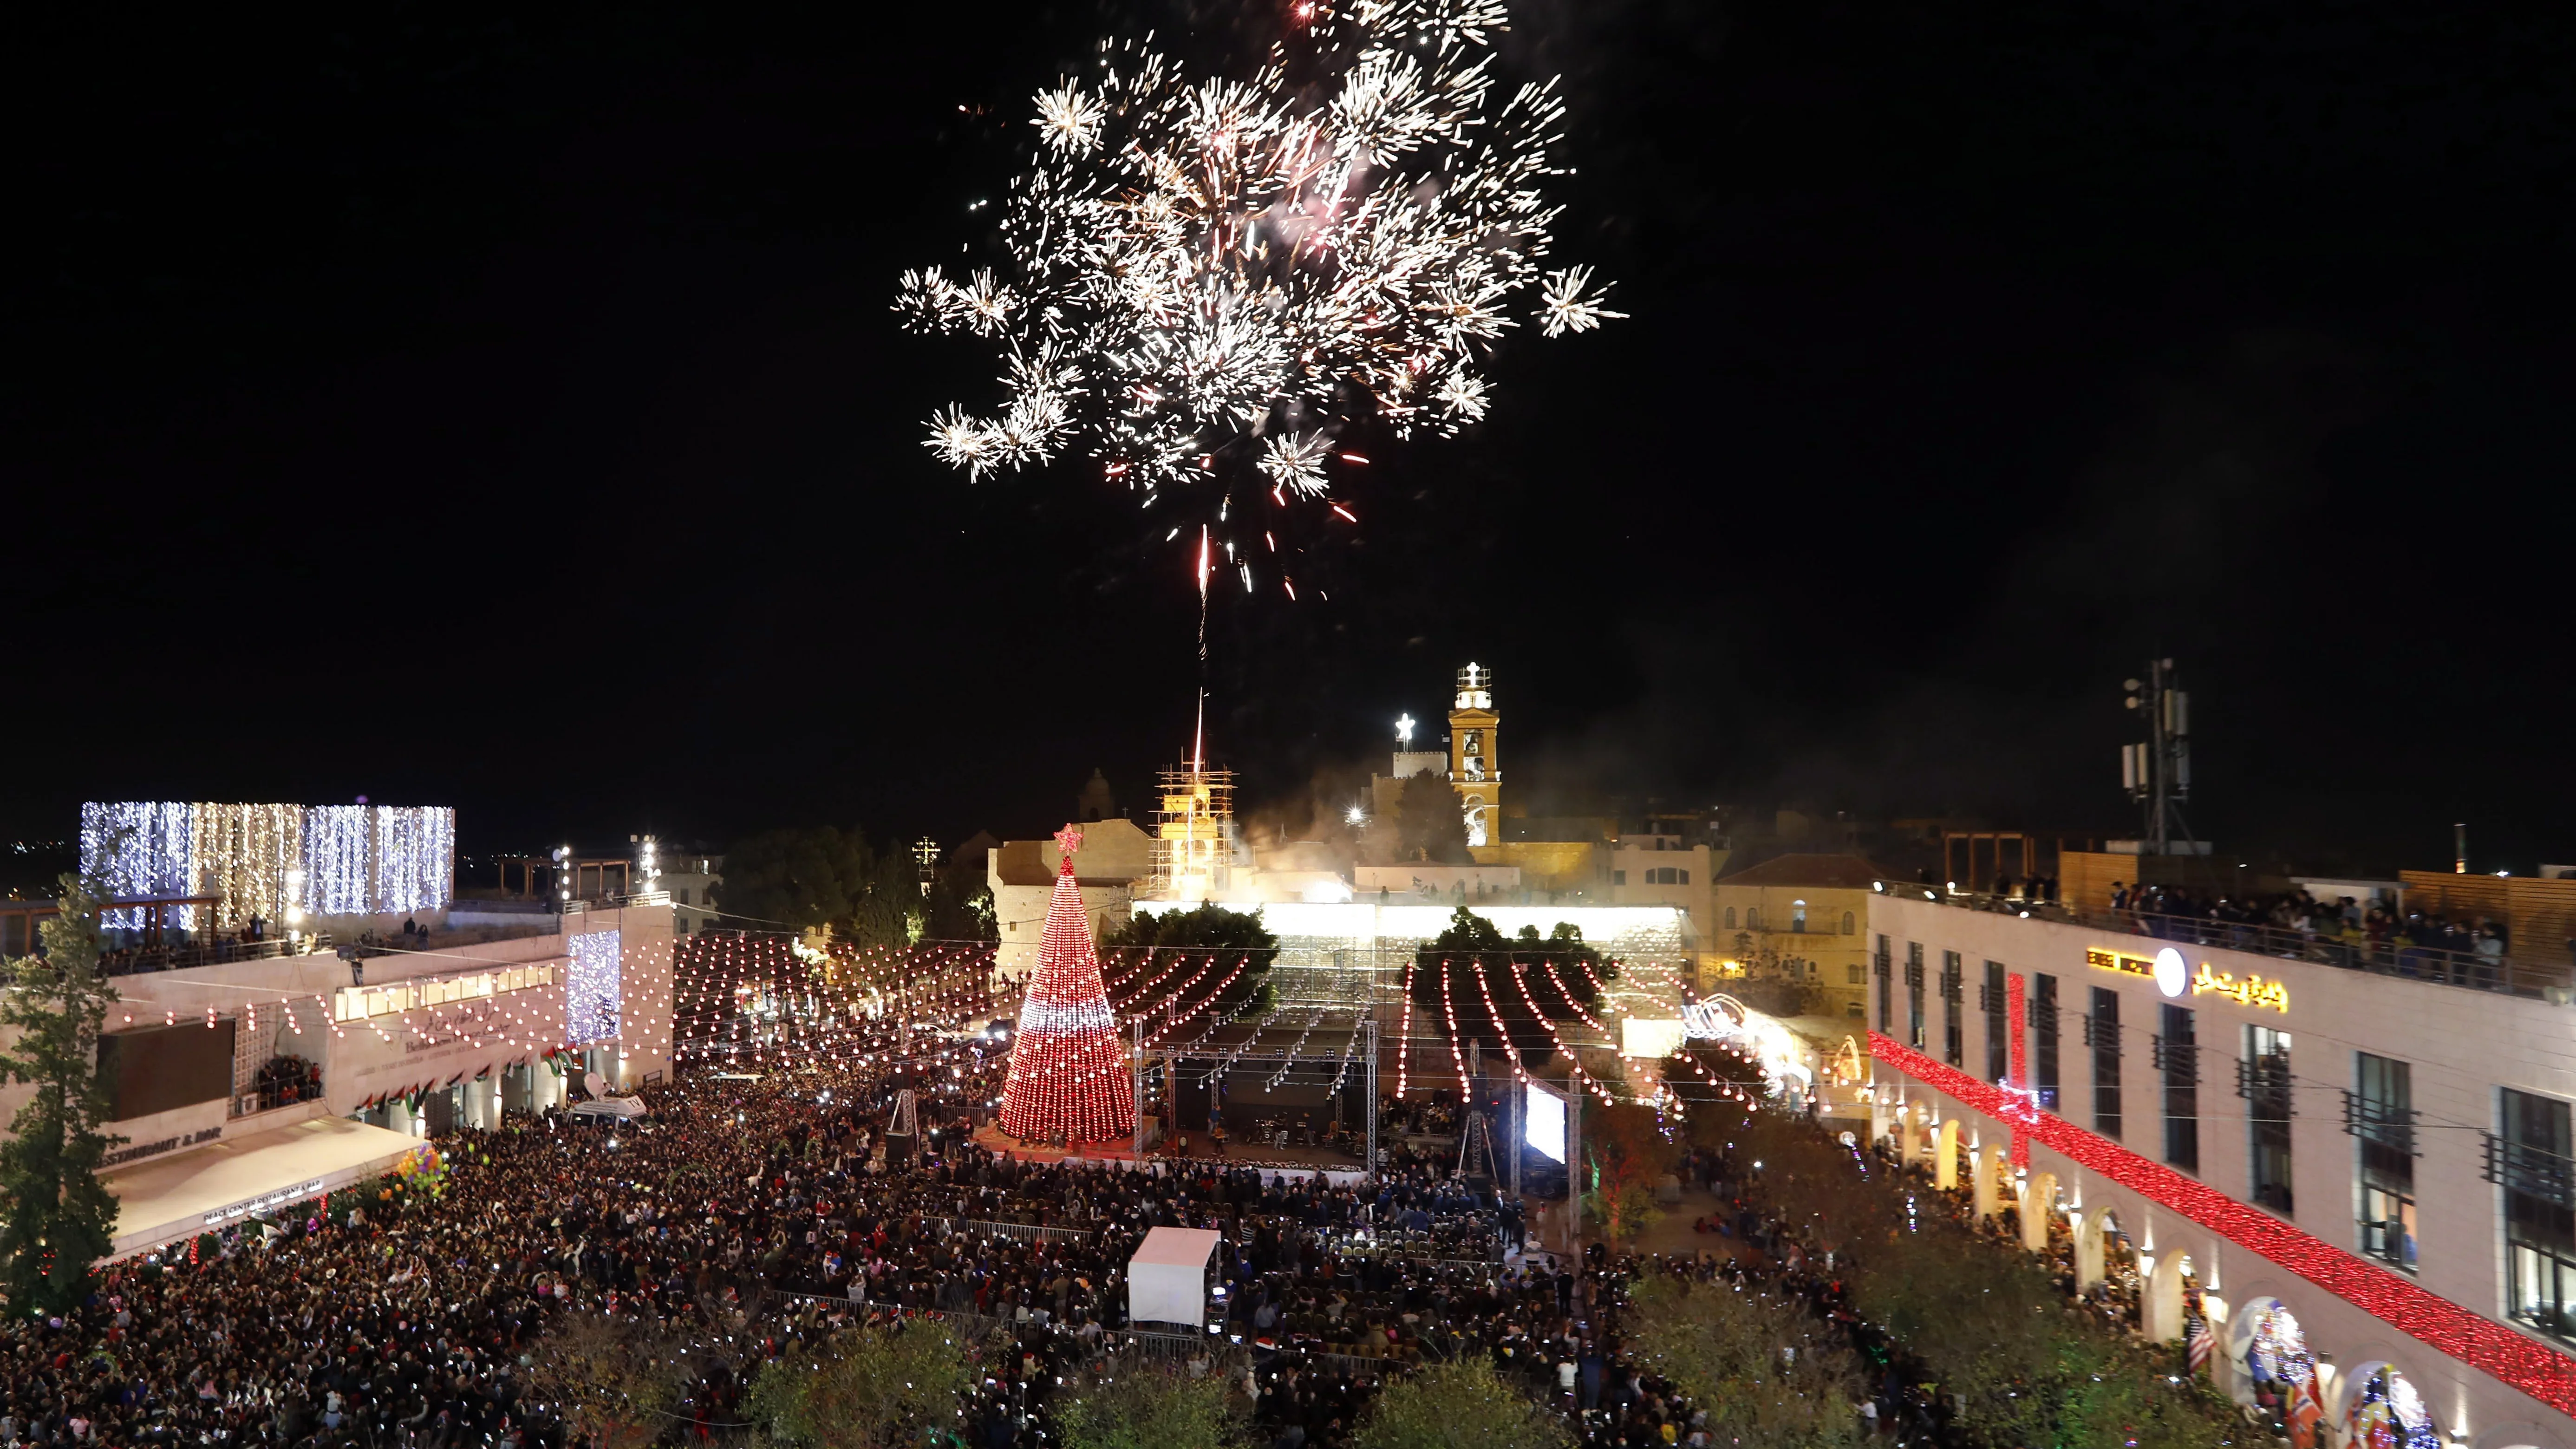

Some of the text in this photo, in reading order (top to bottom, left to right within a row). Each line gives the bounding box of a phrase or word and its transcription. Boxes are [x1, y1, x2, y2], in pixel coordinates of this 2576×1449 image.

[406, 1038, 451, 1053] Bethhem
[483, 1024, 510, 1036] Cnter
[627, 1099, 640, 1108] TV
[96, 1136, 181, 1168] ESTAURANT
[203, 1208, 227, 1221] PEACE
[228, 1199, 256, 1213] CENTER
[257, 1187, 300, 1203] RESTAURANT
